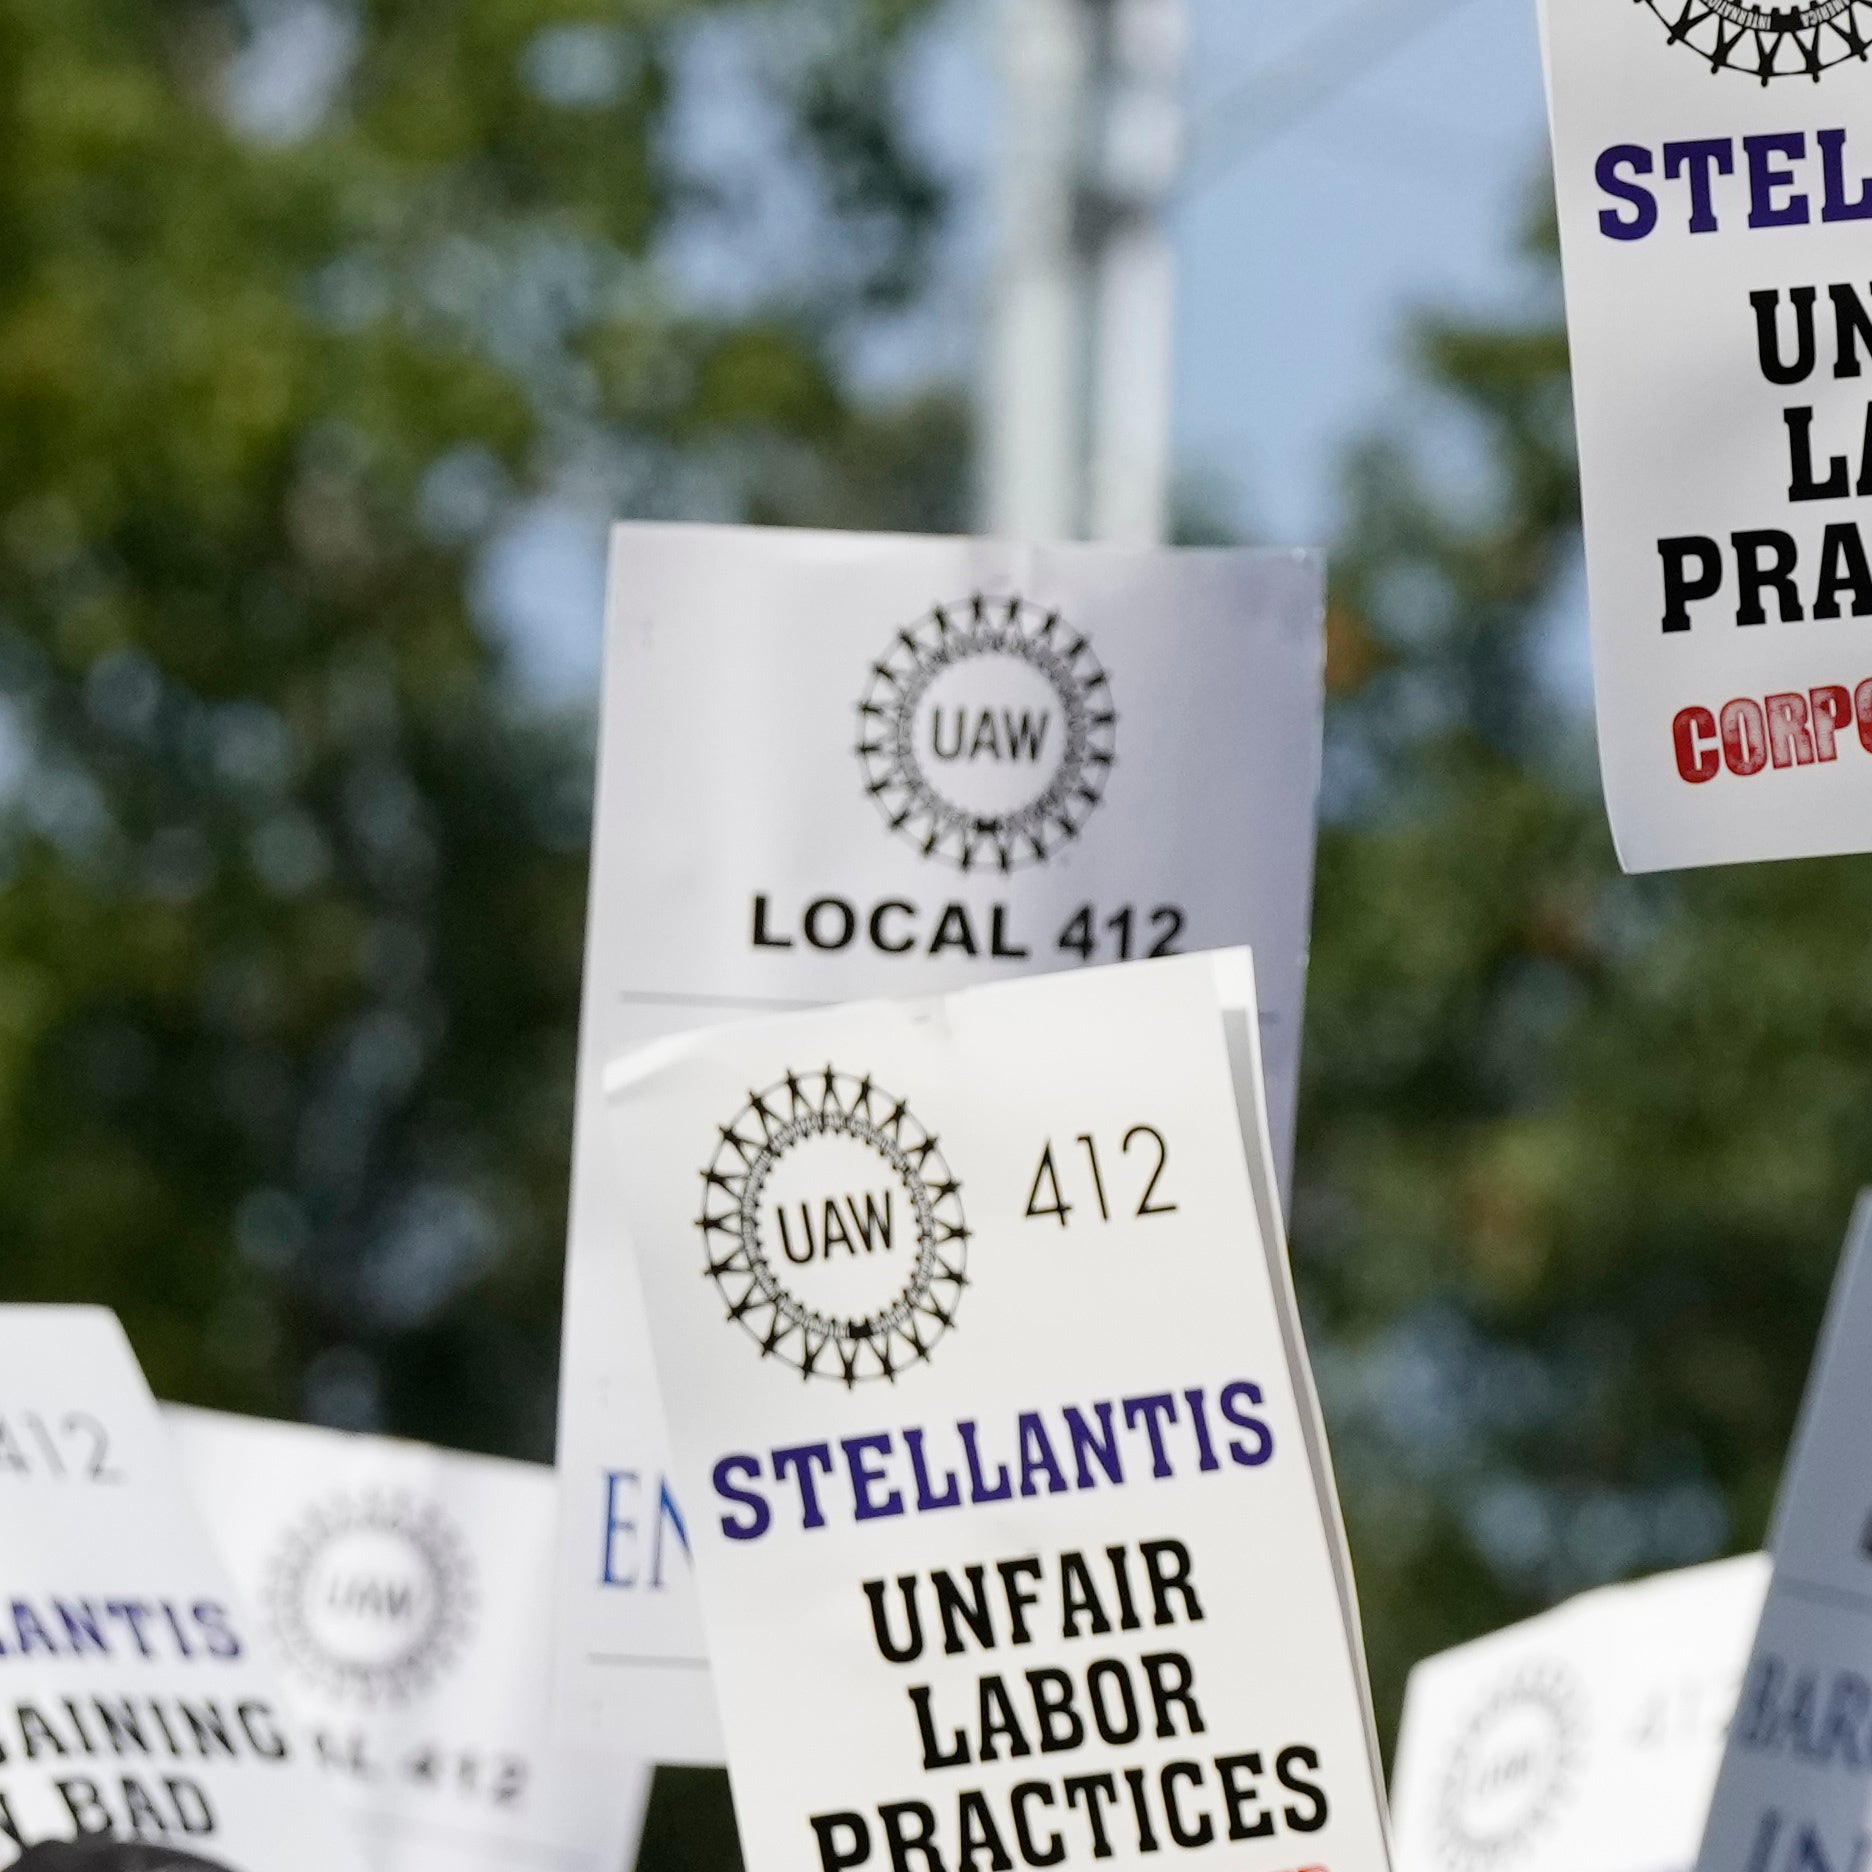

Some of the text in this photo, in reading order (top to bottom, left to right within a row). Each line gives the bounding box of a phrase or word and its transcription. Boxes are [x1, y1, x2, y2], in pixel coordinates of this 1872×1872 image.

[928, 705, 1049, 765] UAW
[752, 895, 1187, 960] LOCAL 412
[1024, 1124, 1178, 1226] 412
[776, 1188, 893, 1265] UAW
[712, 1379, 1275, 1544] STELLANTIS
[0, 1600, 243, 1660] ANTIS
[862, 1539, 1207, 1665] UNFAIR
[0, 1699, 288, 1763] AINING
[907, 1652, 1210, 1773] LABOR
